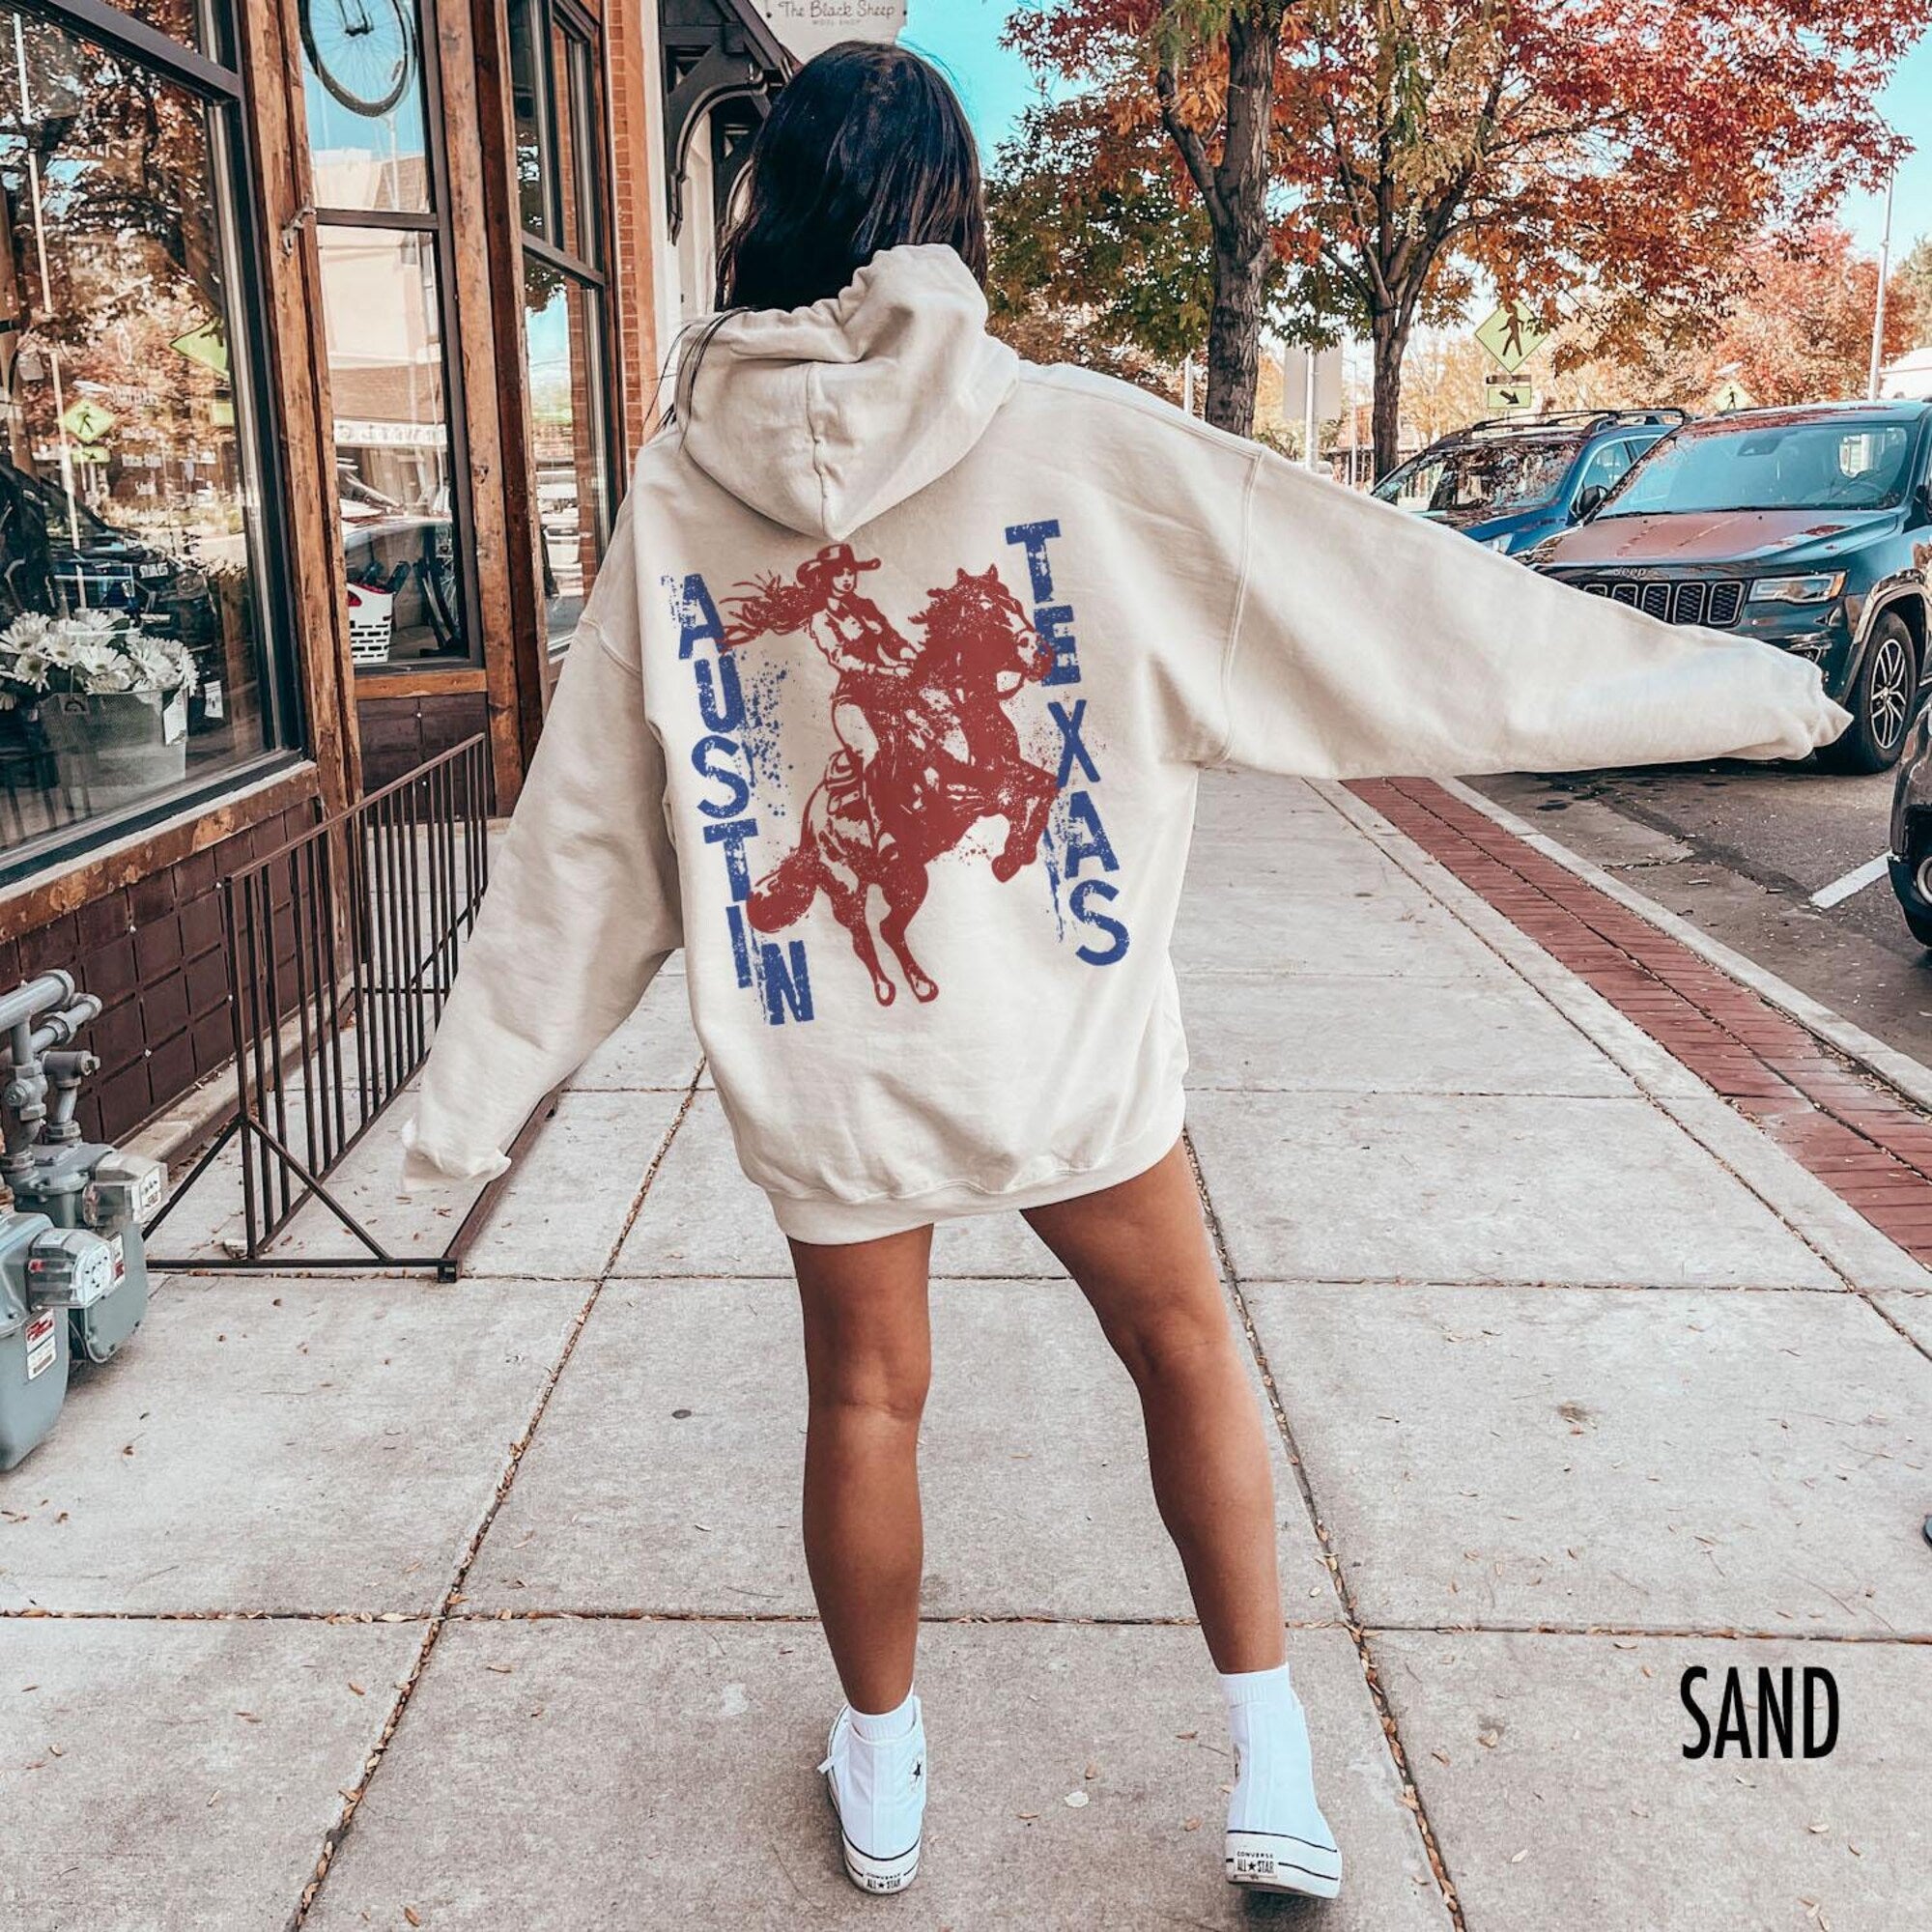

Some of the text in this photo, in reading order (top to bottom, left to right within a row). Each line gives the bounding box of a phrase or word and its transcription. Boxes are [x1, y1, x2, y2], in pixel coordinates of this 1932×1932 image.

[778, 0, 895, 18] The Black Sheep
[1613, 567, 1647, 579] Jeep
[1005, 520, 1131, 967] TEXAS
[676, 573, 814, 1026] AUSTIN
[1236, 1858, 1274, 1874] ALL STAR
